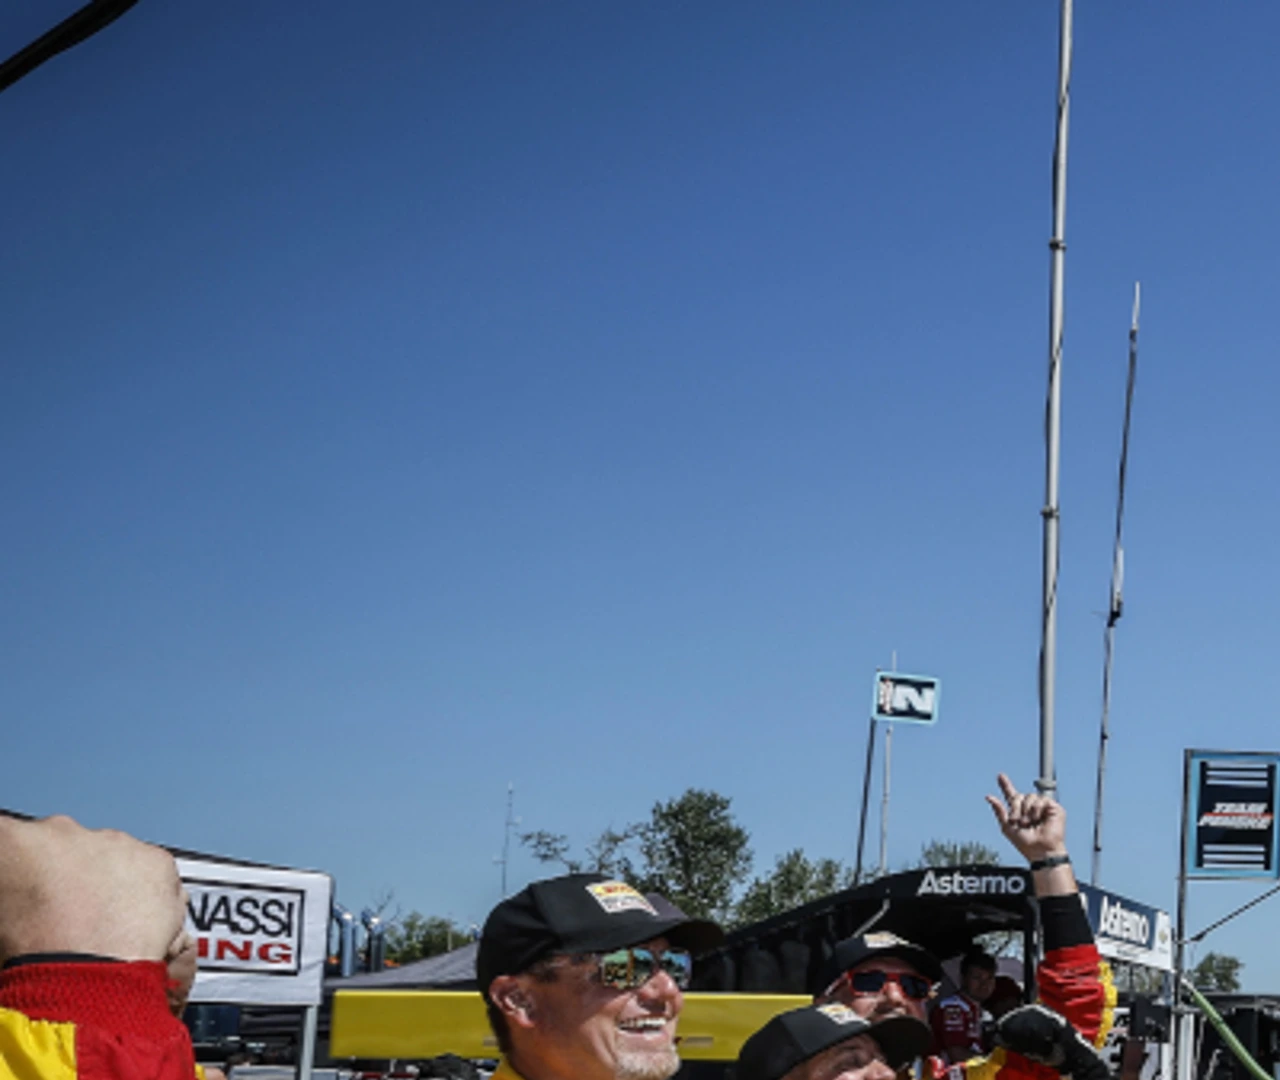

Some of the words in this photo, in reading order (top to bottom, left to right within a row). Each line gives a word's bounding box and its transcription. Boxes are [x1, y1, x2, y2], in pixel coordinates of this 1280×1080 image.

[1212, 801, 1268, 813] TEAM
[1198, 815, 1272, 830] PENSKE
[917, 870, 1026, 897] Astemo
[1100, 894, 1150, 945] Astemo
